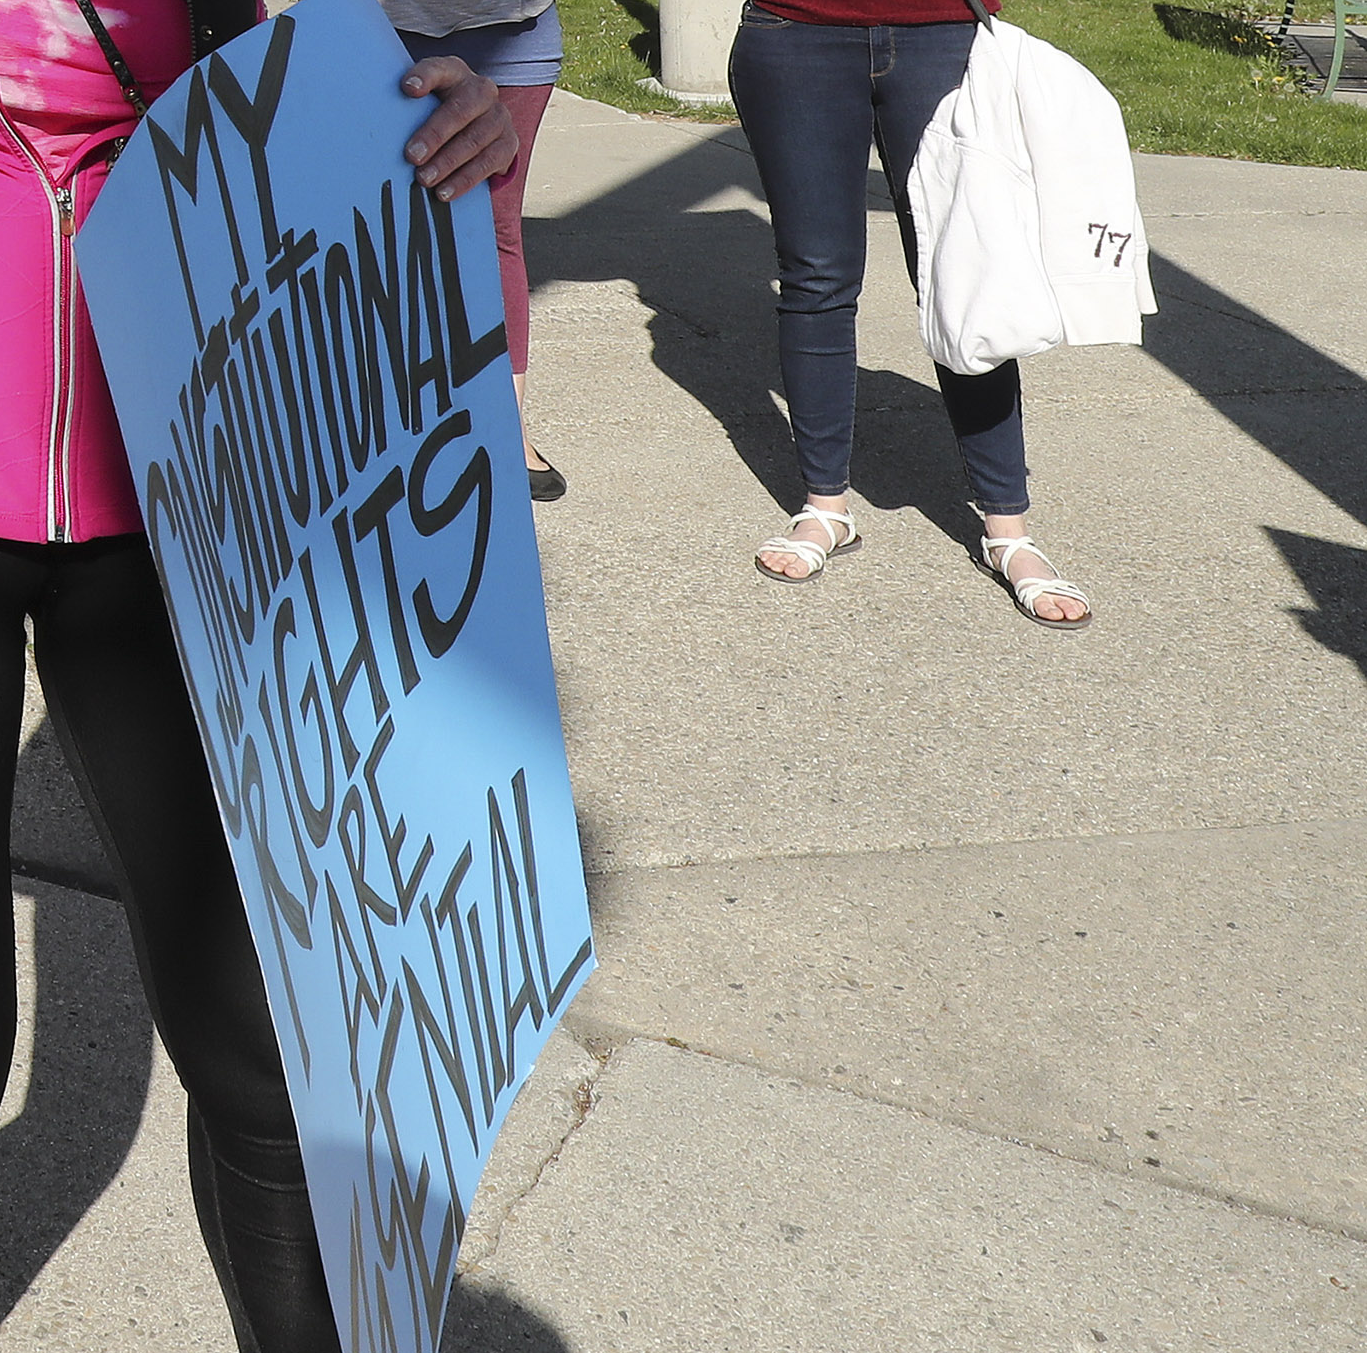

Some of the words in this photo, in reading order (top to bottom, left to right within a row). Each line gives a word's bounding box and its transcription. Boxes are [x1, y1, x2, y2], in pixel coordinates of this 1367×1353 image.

[144, 14, 295, 352] MY
[1087, 222, 1132, 268] 77
[146, 178, 509, 841] CONSTITUTIONAL
[240, 409, 493, 1090] RIGHTS
[324, 713, 435, 1118] ARE
